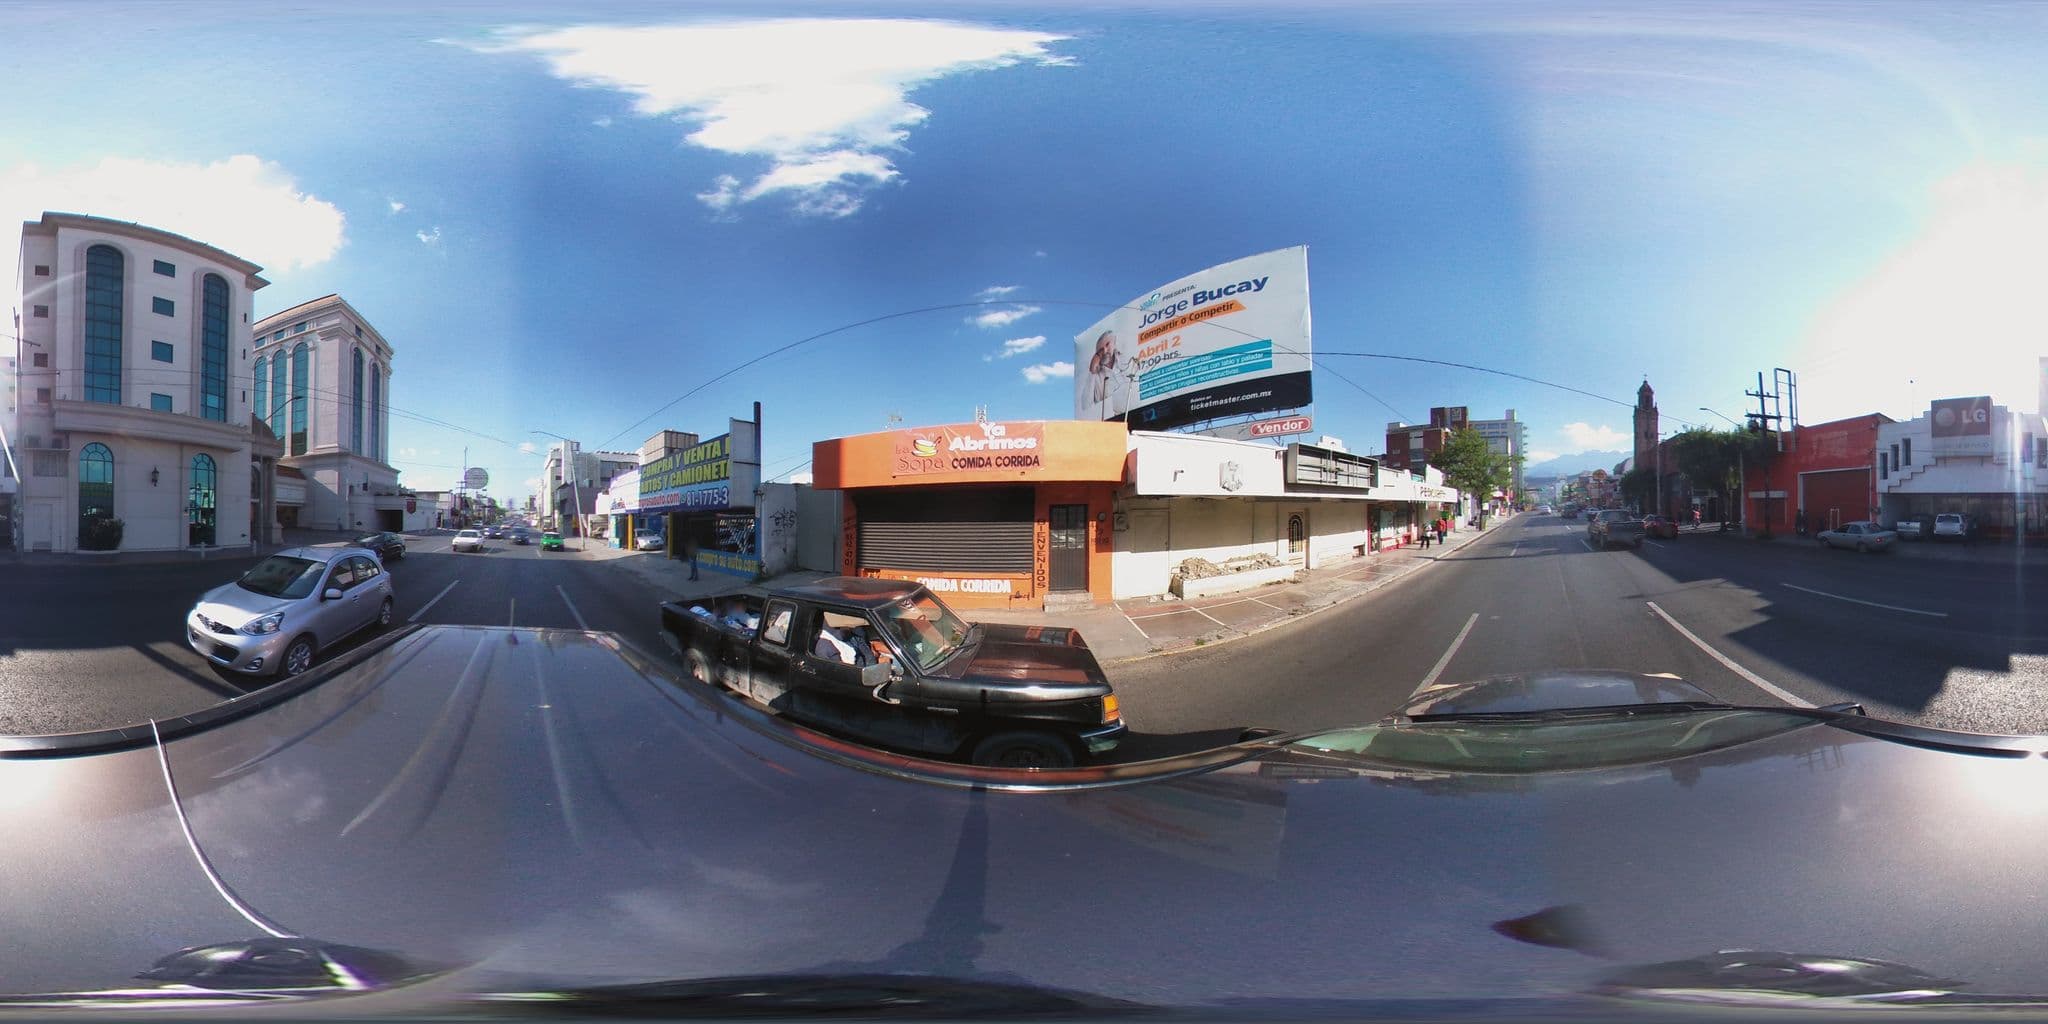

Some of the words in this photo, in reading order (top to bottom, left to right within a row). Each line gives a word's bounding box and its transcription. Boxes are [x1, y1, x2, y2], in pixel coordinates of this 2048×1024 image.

[1139, 300, 1188, 328] Jorge
[1192, 276, 1269, 306] Bucay
[1140, 320, 1178, 341] Compartir
[1181, 316, 1186, 324] o
[1189, 302, 1235, 321] Competir
[1138, 340, 1168, 360] Abril
[1172, 335, 1181, 347] 2
[1137, 354, 1162, 370] 17:00
[1163, 349, 1181, 361] hrs.
[1190, 390, 1272, 411] ticketmaster.com.mx
[1961, 408, 1986, 424] LG
[979, 422, 1006, 437] Ya
[1257, 421, 1304, 433] Vendor
[949, 435, 1038, 451] Abrimos
[641, 456, 673, 478] COMPRA
[675, 452, 682, 467] Y
[683, 440, 721, 465] VENTA
[897, 456, 944, 472] Sopa
[951, 457, 992, 469] COMIDA
[995, 455, 1040, 468] CORRIDA
[663, 476, 669, 489] Y
[1036, 518, 1047, 589] BIENVENIDOS
[916, 577, 958, 592] COMIDA
[960, 579, 1011, 593] CORRIDA
